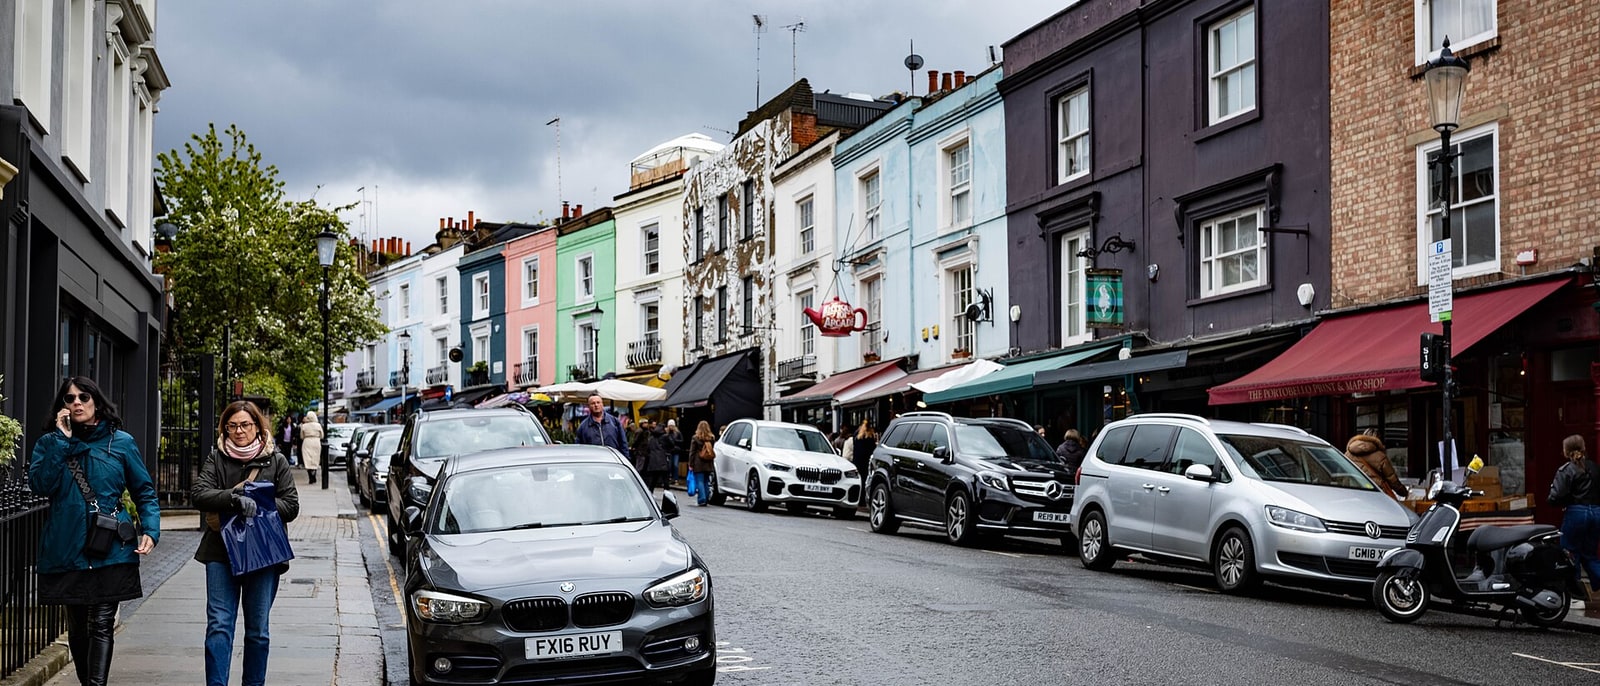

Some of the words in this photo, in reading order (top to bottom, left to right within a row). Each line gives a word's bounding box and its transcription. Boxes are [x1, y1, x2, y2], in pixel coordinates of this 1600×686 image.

[1248, 390, 1263, 400] THE
[1263, 384, 1311, 399] PORTOBELLO
[1312, 383, 1336, 393] PRINT
[1337, 382, 1344, 392] &
[1345, 379, 1362, 391] MAP
[1363, 377, 1386, 390] SHOP
[1355, 547, 1376, 559] GM18
[1377, 550, 1387, 559] X
[536, 637, 574, 655] FX16
[578, 634, 611, 652] RUY
